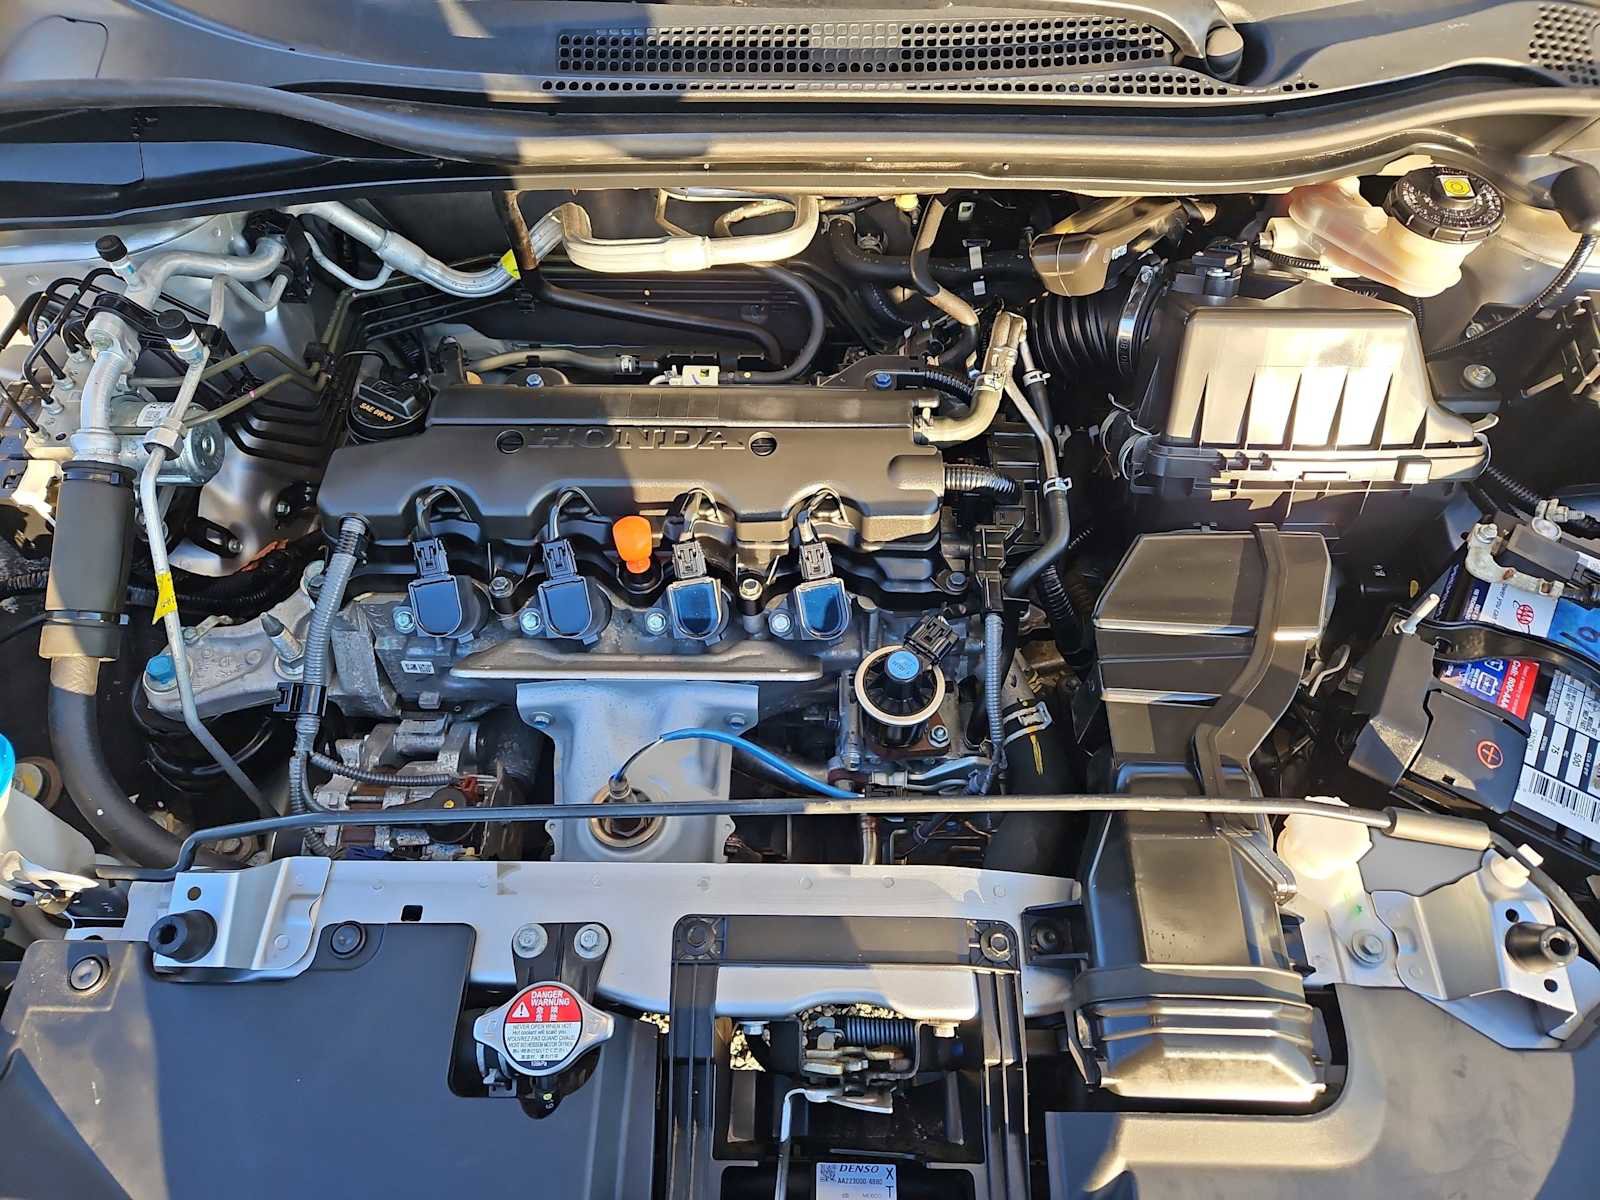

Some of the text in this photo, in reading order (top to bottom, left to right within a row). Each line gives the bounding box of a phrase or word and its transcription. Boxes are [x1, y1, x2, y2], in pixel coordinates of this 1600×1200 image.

[360, 402, 375, 413] SAE
[527, 427, 746, 451] HONDA
[1551, 744, 1560, 755] 75
[1572, 752, 1582, 768] 500
[531, 991, 564, 999] DANGER
[531, 998, 570, 1006] WARNUNG
[839, 1164, 894, 1180] DENSO X
[886, 1185, 894, 1198] T
